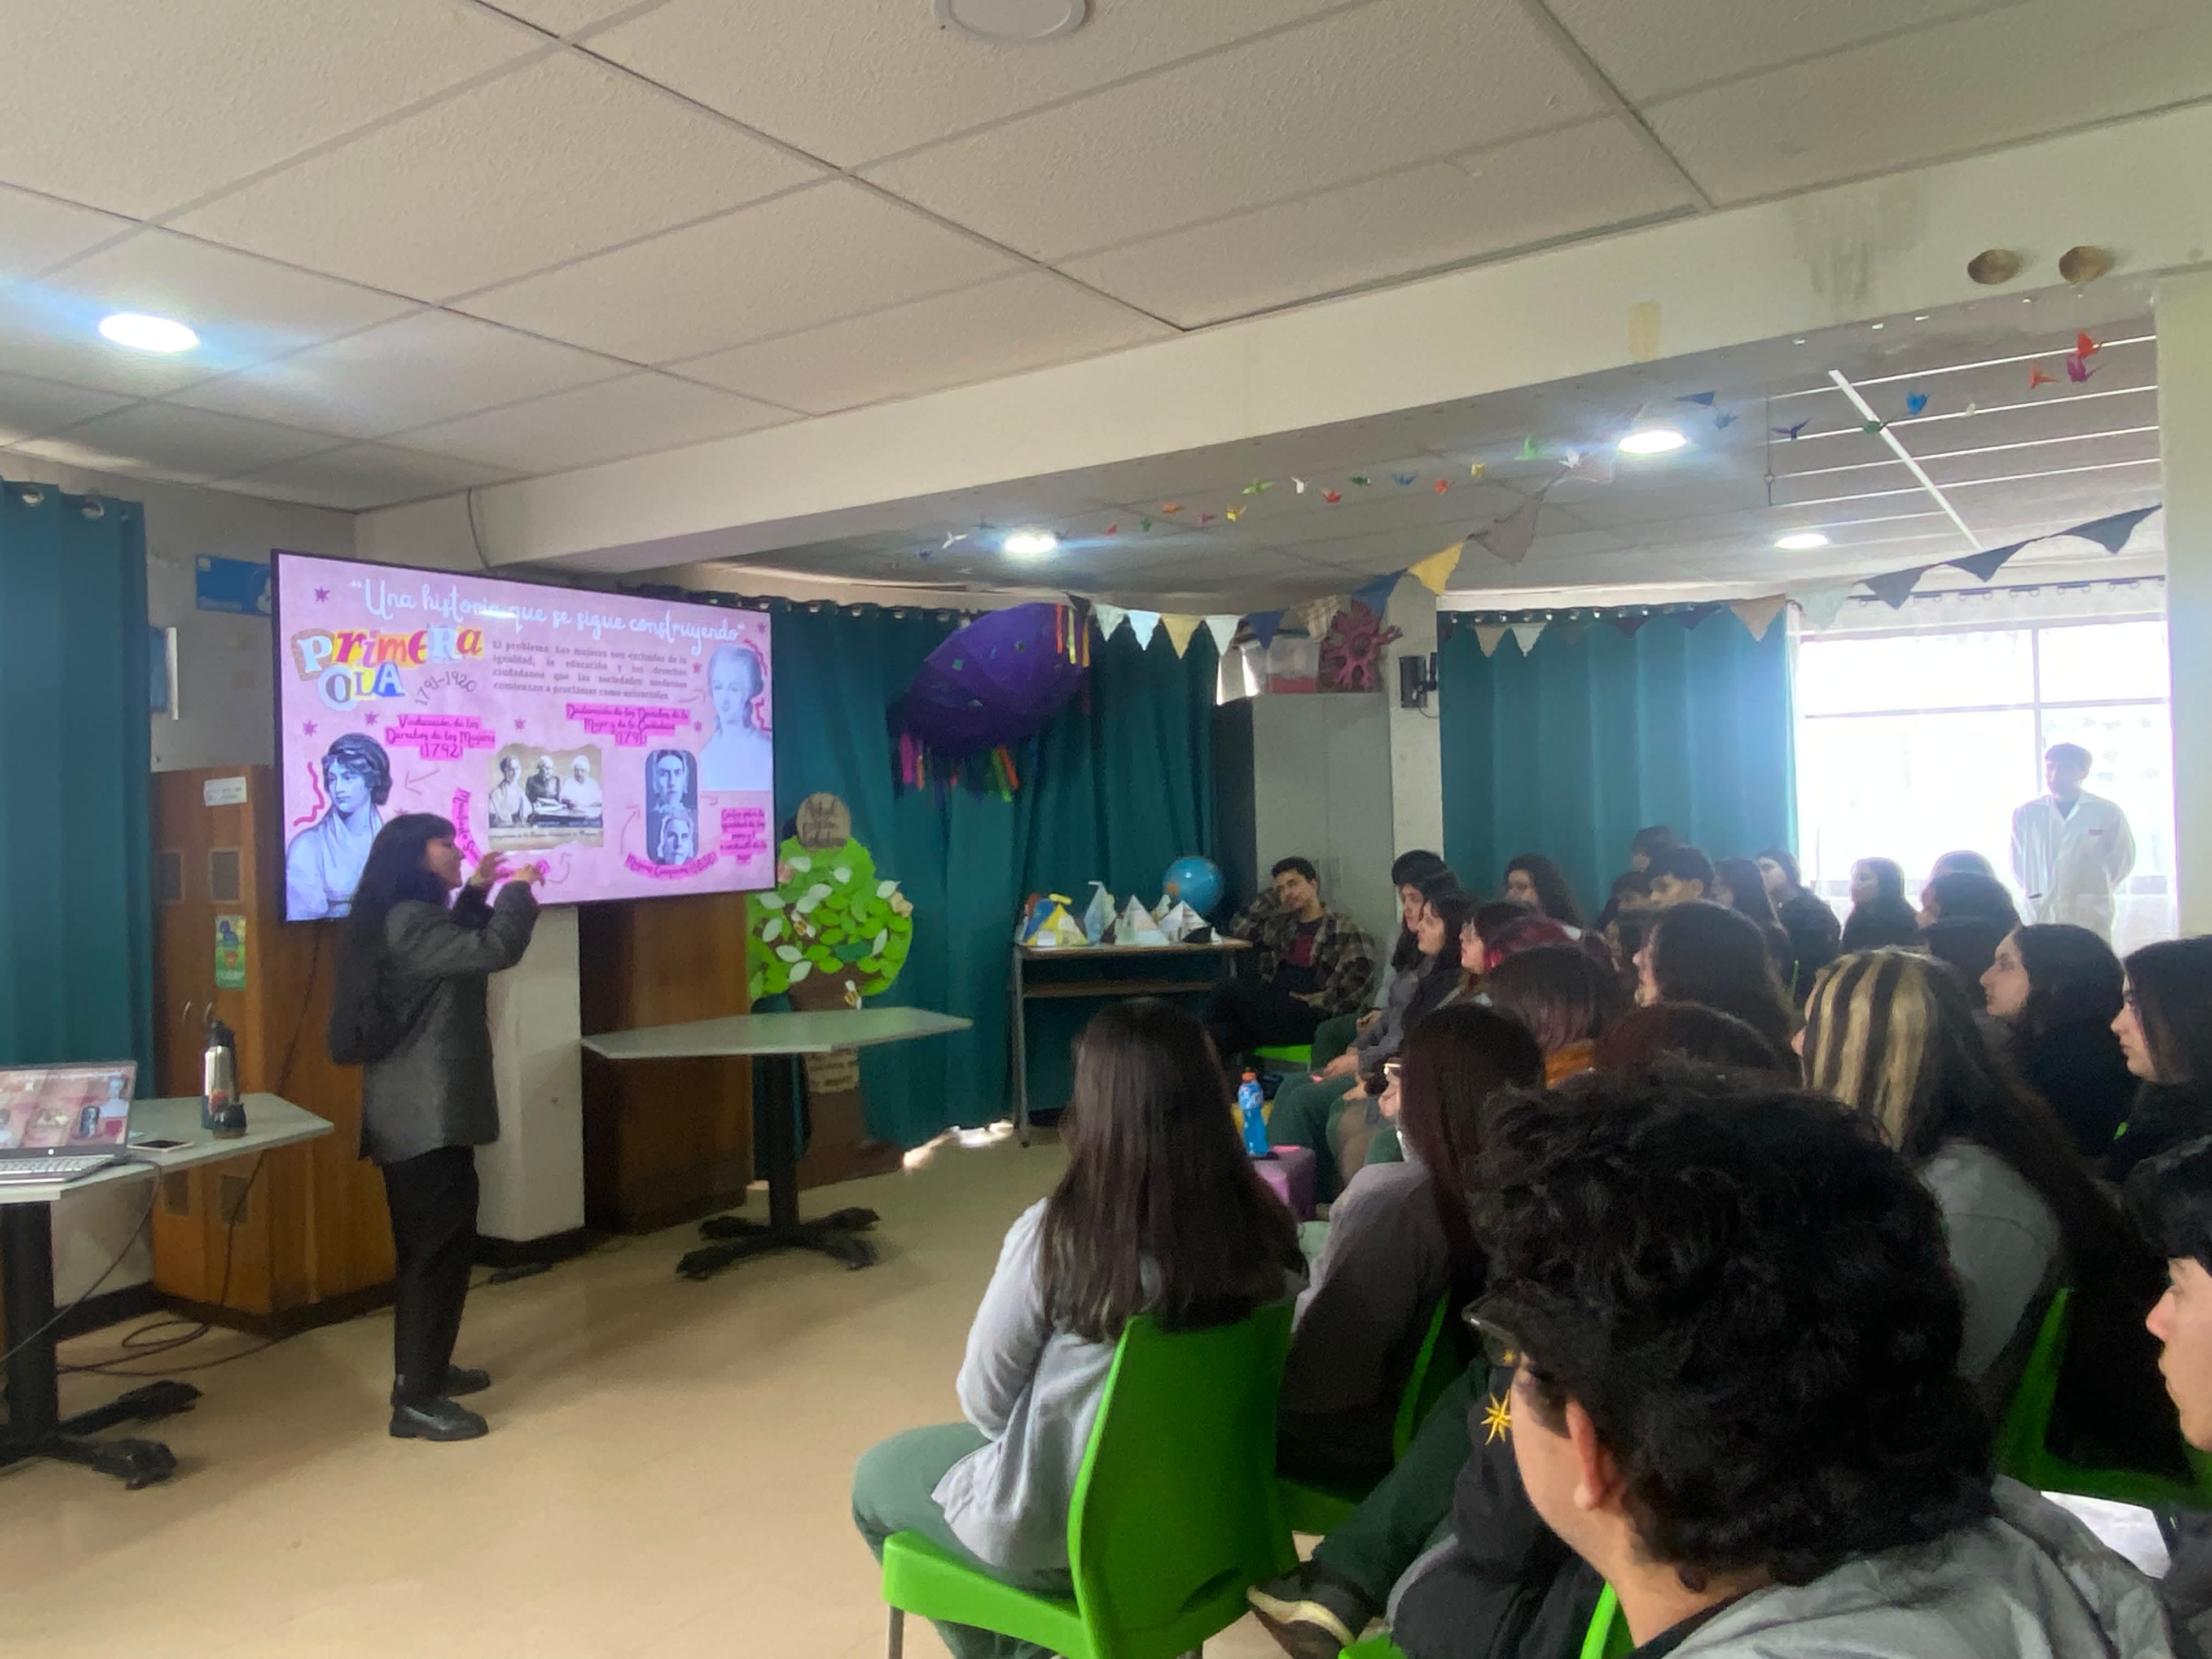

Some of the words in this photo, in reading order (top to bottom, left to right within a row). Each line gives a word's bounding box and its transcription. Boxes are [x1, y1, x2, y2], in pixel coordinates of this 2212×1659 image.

[510, 605, 548, 633] que
[552, 609, 571, 629] se
[577, 609, 626, 641] sigue
[326, 662, 406, 703] OLA
